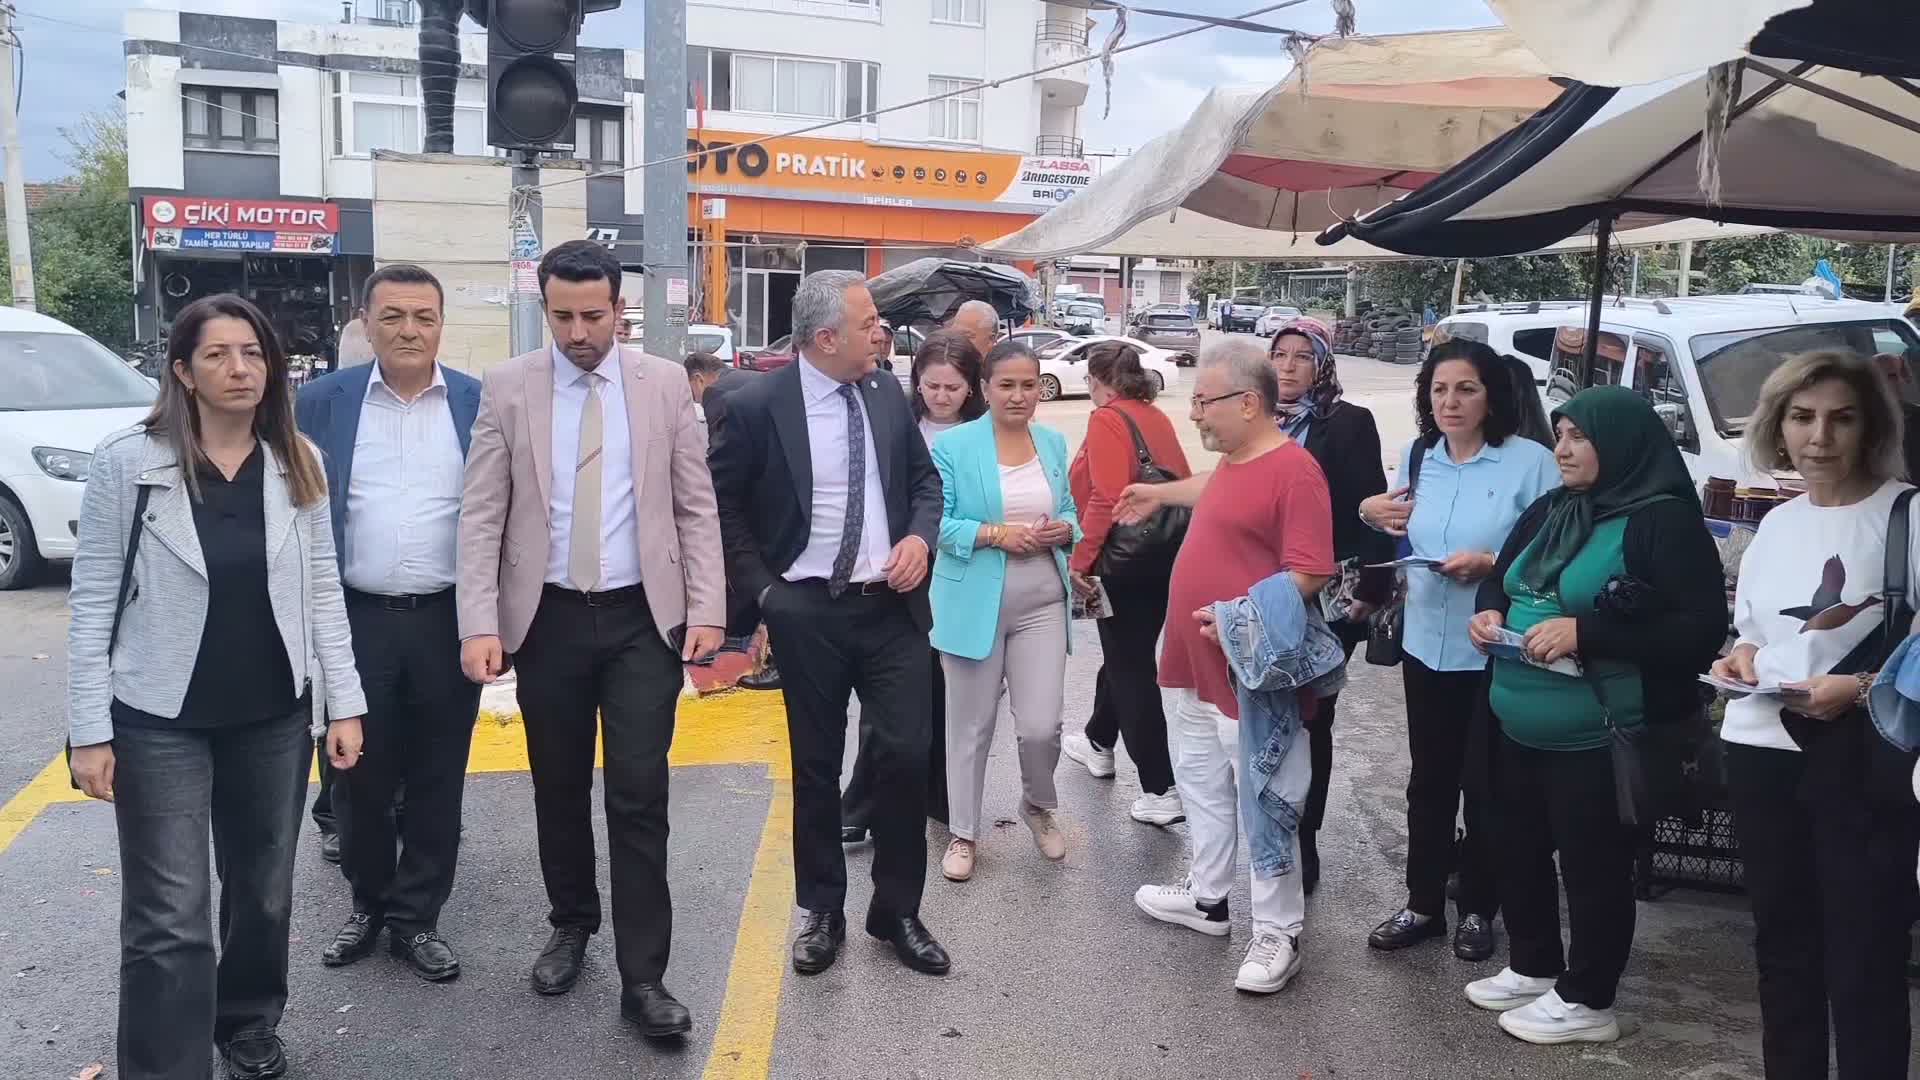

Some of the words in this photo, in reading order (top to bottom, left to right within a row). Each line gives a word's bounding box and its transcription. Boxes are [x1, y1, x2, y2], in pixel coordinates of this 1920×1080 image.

[686, 138, 769, 177] OTO
[775, 152, 866, 179] PRATİK
[1039, 159, 1090, 172] LASSA
[1021, 170, 1090, 185] BRIDGESTONE
[184, 201, 230, 225] ÇİKİ
[237, 207, 328, 230] MOTOR
[204, 231, 221, 240] HER
[222, 231, 249, 240] TÜRLÜ
[240, 240, 270, 249] YAPILIR
